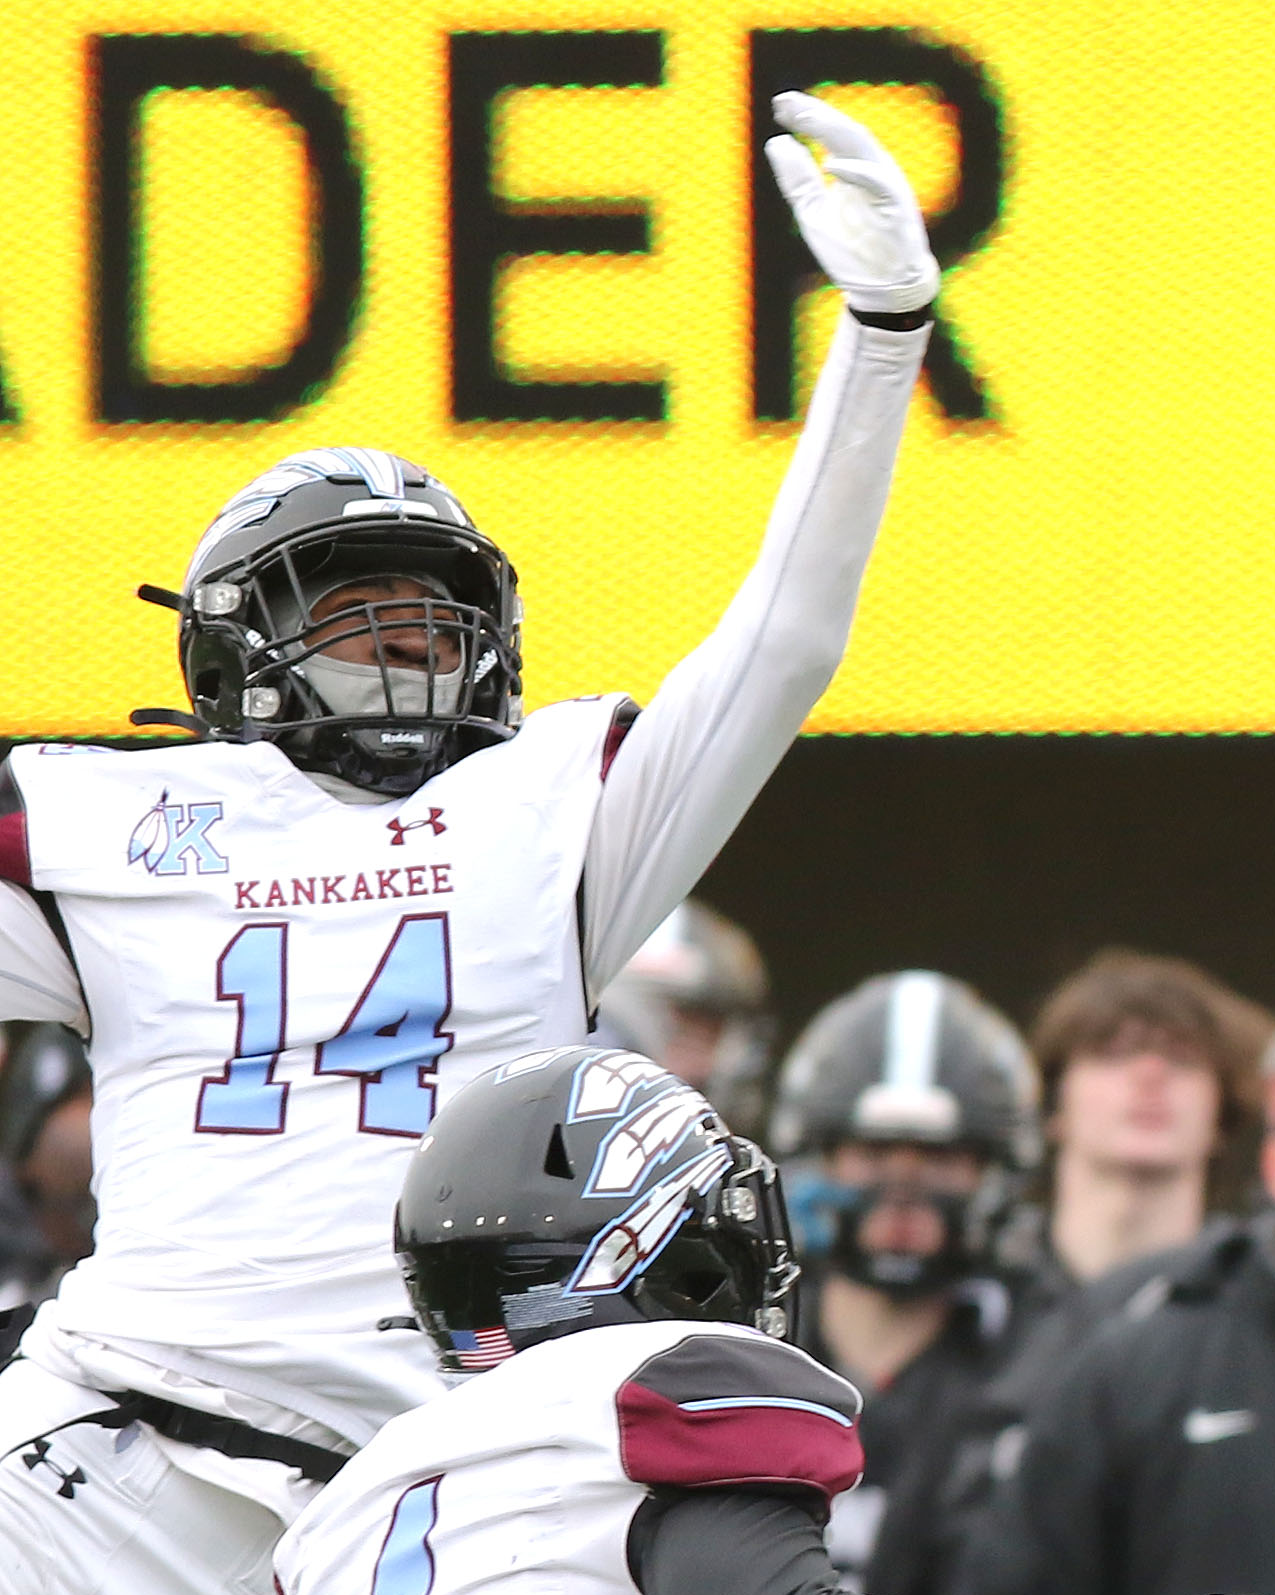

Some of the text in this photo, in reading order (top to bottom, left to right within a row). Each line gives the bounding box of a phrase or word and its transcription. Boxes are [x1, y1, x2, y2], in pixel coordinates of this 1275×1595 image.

[0, 28, 1003, 426] DER
[234, 863, 455, 910] KANKAKEE
[193, 910, 455, 1139] 14
